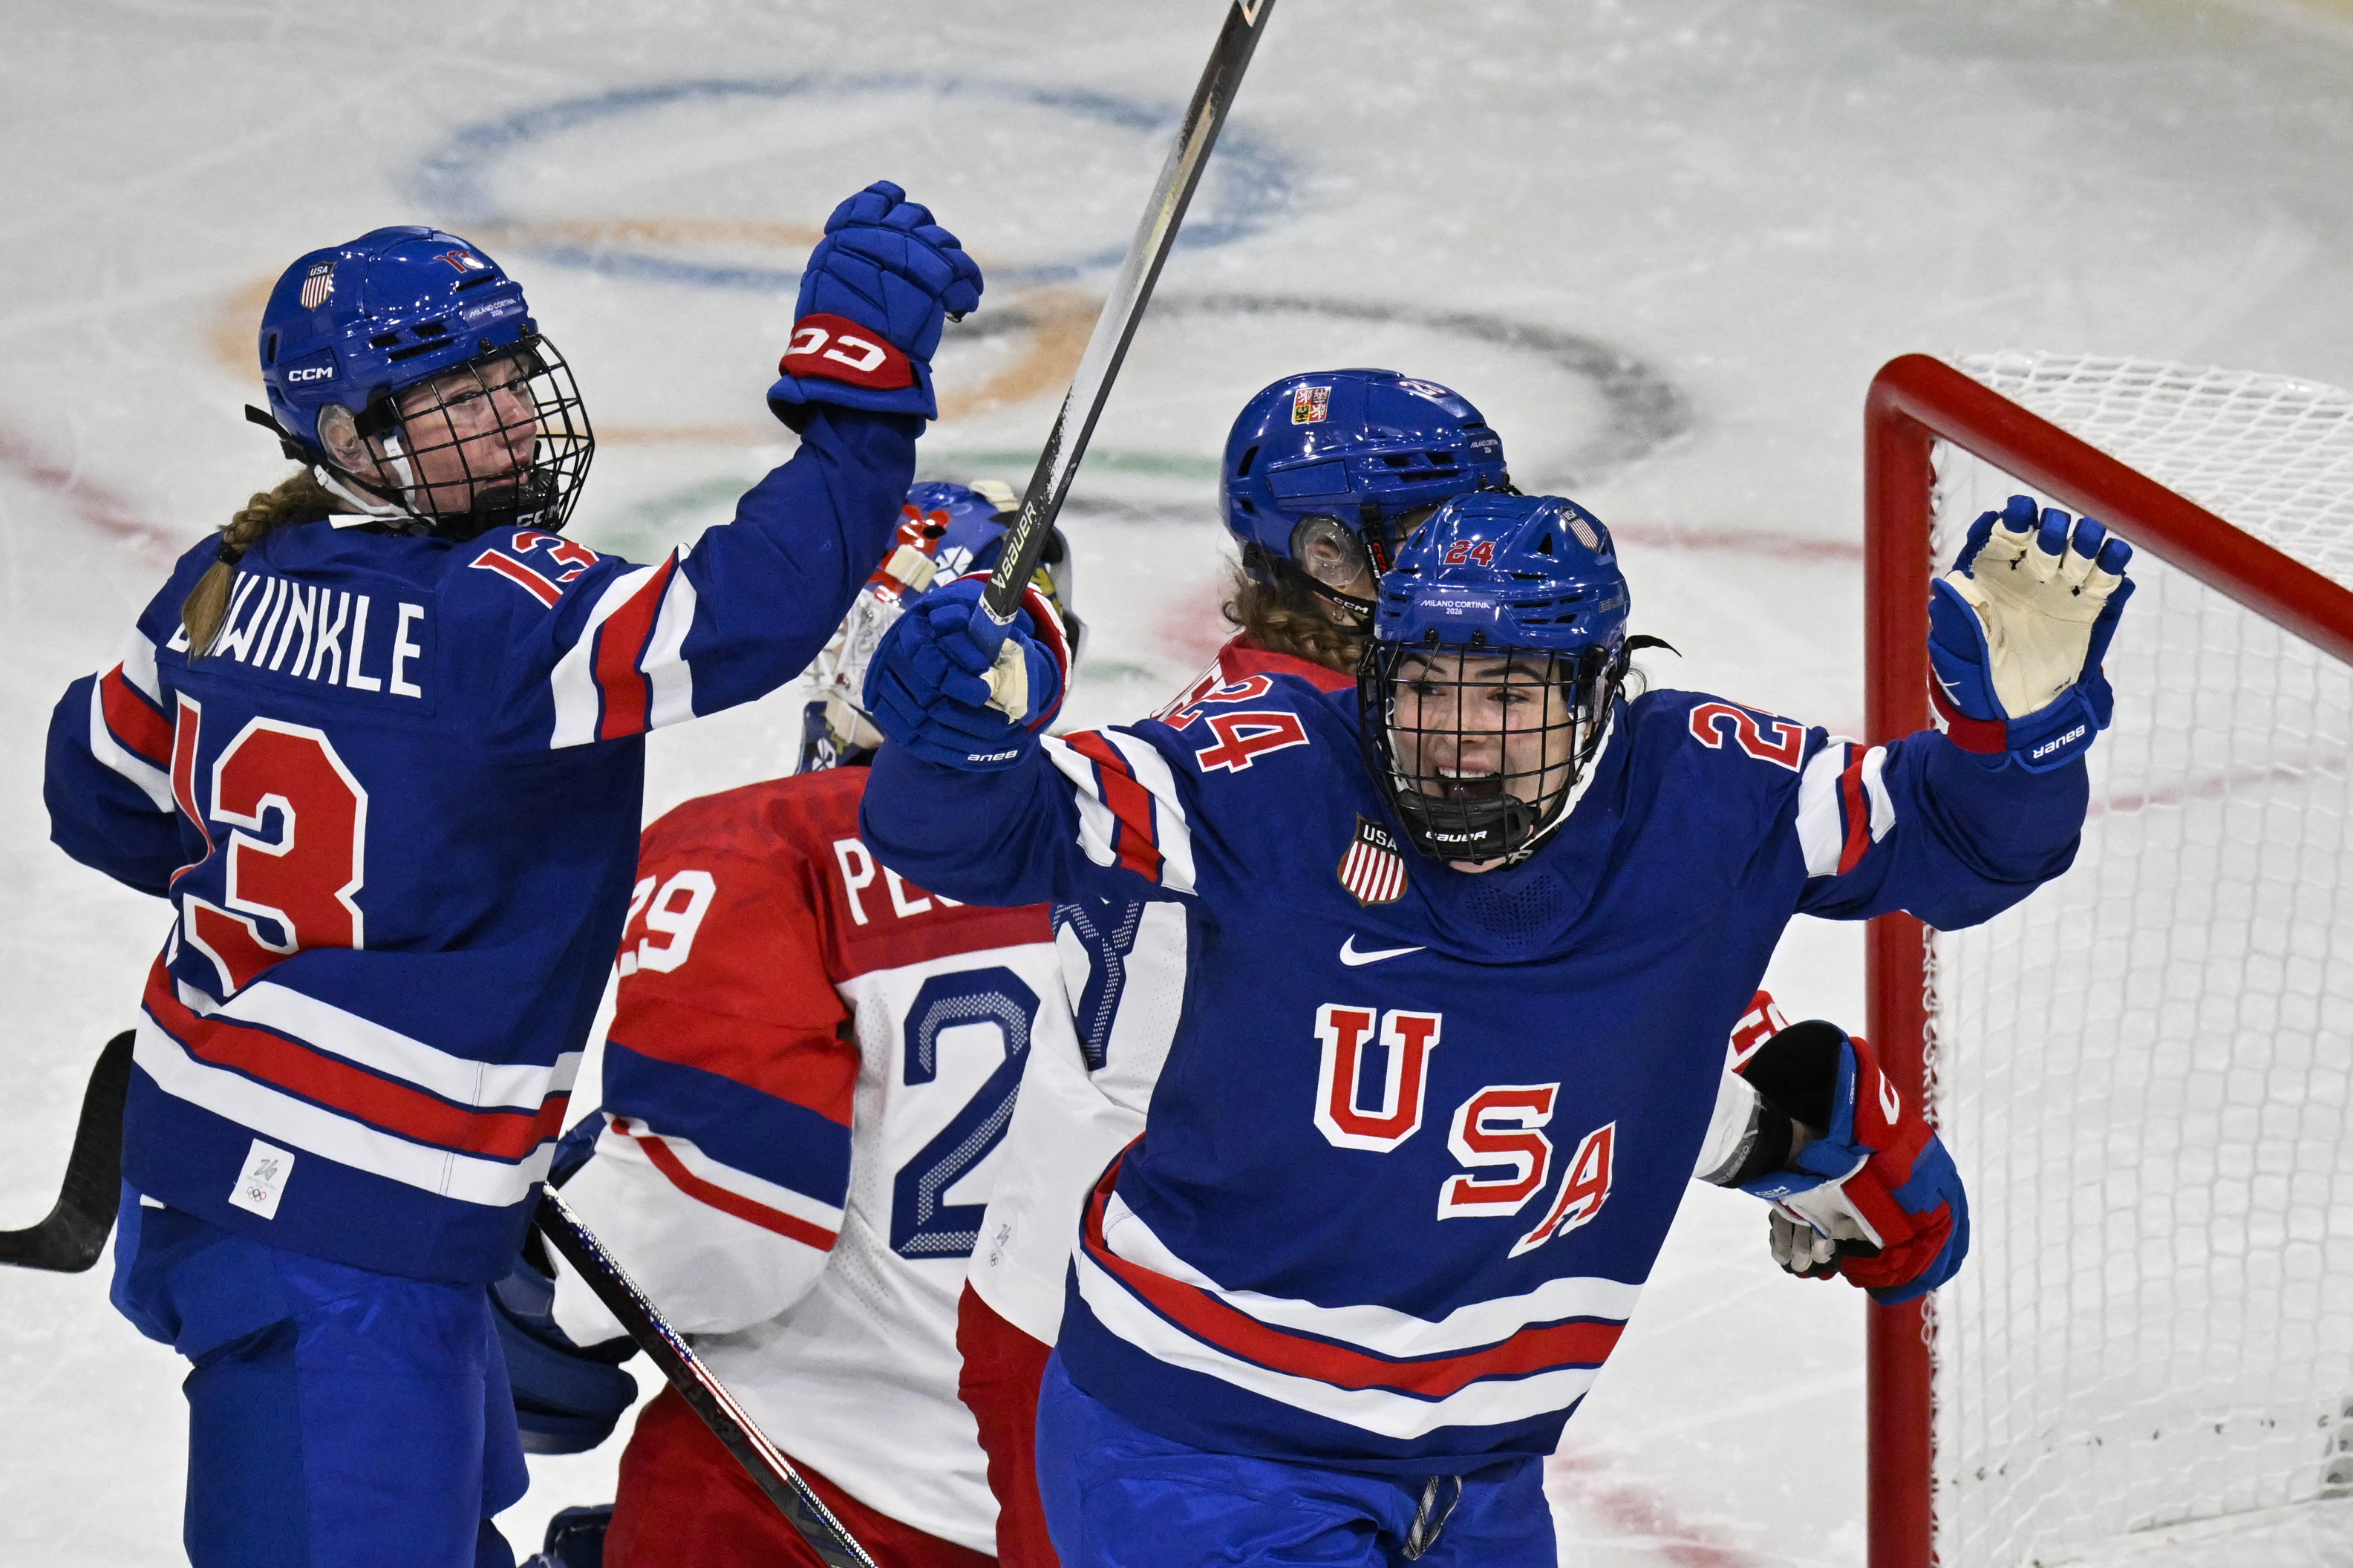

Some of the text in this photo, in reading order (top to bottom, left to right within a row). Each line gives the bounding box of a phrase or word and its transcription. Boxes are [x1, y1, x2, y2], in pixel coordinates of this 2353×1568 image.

[309, 264, 329, 277] USA
[469, 304, 494, 318] MILANO
[783, 327, 887, 372] CC
[288, 367, 333, 382] CCM
[1562, 510, 1578, 520] USA
[1001, 500, 1037, 581] BAUER
[1443, 540, 1497, 567] 24
[468, 530, 601, 610] 13
[1333, 596, 1369, 614] CCM
[1420, 599, 1491, 610] MILANO CORTINA
[1446, 607, 1463, 615] 2026
[166, 571, 425, 699] WINKLE
[1162, 674, 1311, 774] 24
[1688, 702, 1807, 774] 2
[2032, 724, 2085, 759] BAUER
[169, 688, 369, 999] 13
[1362, 824, 1398, 852] USA
[1425, 829, 1488, 843] BAUER
[889, 965, 1041, 1260] 2
[1313, 1003, 1616, 1259] USA
